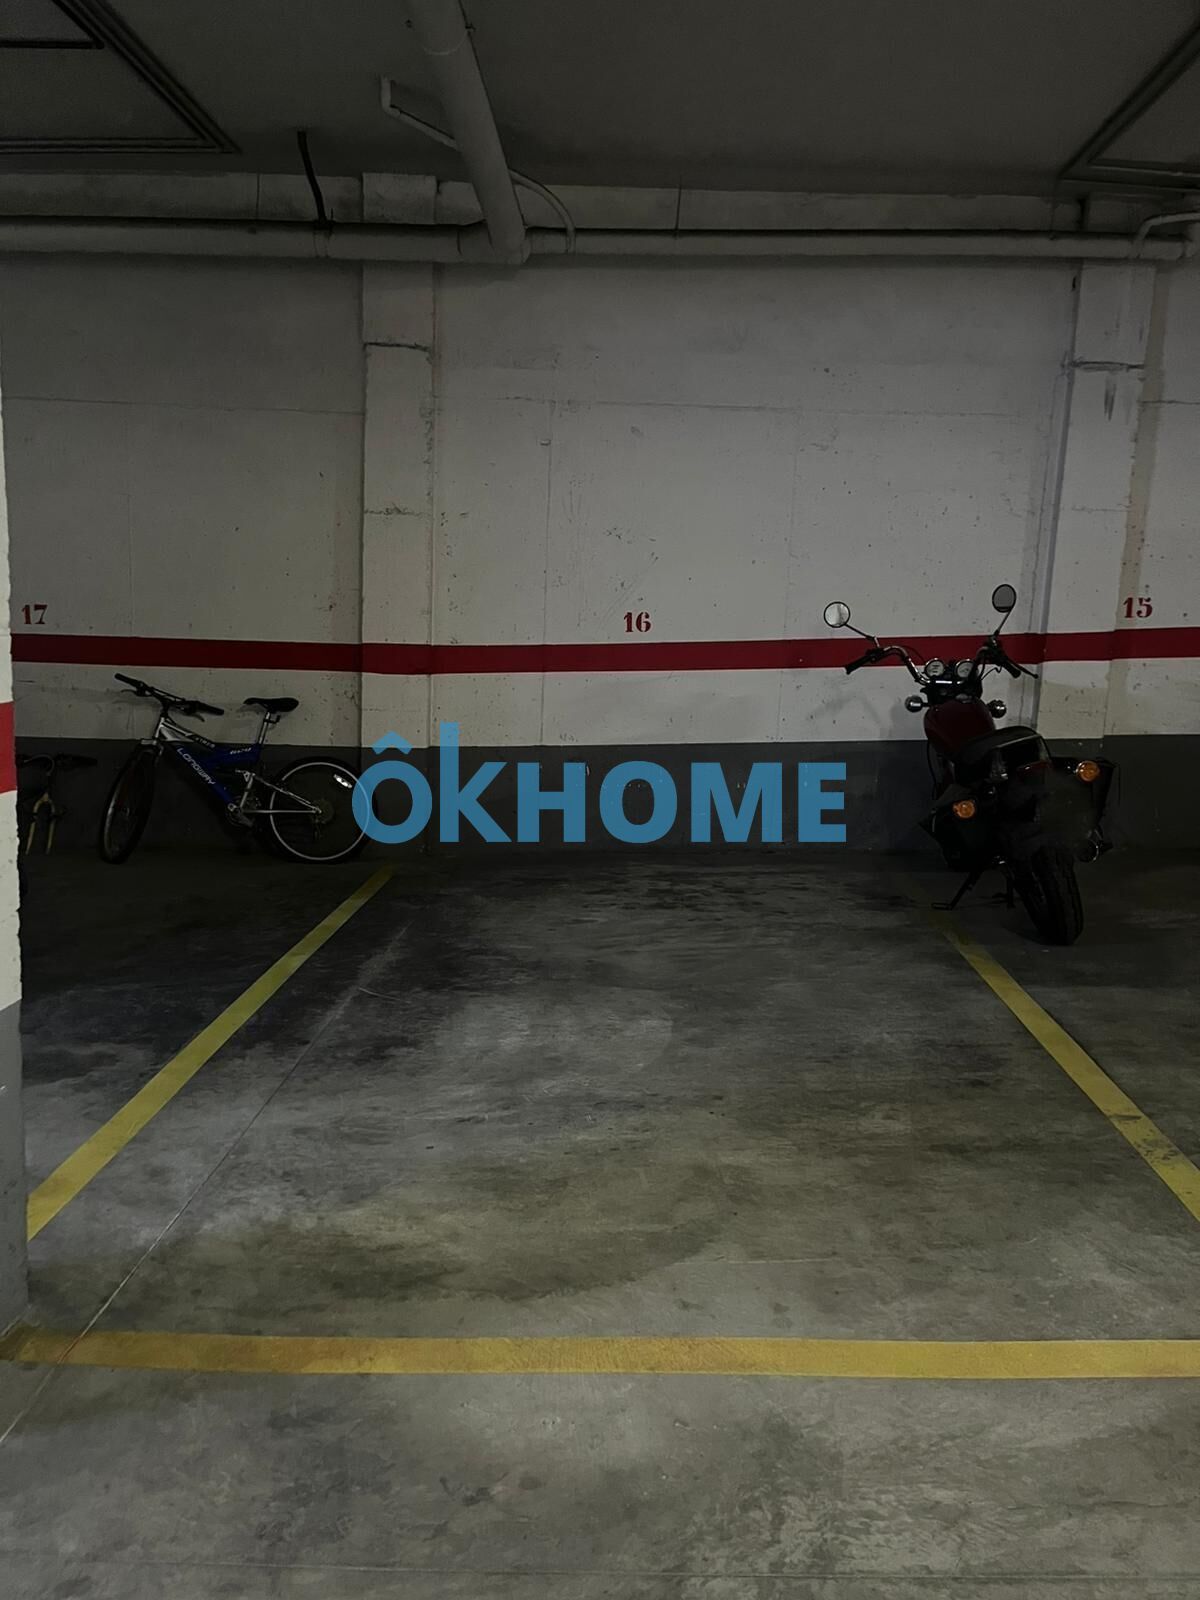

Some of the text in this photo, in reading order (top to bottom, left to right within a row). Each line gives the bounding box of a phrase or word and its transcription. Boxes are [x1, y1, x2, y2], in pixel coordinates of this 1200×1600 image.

[22, 604, 47, 625] 17
[1123, 597, 1152, 618] 15
[623, 612, 651, 632] 16
